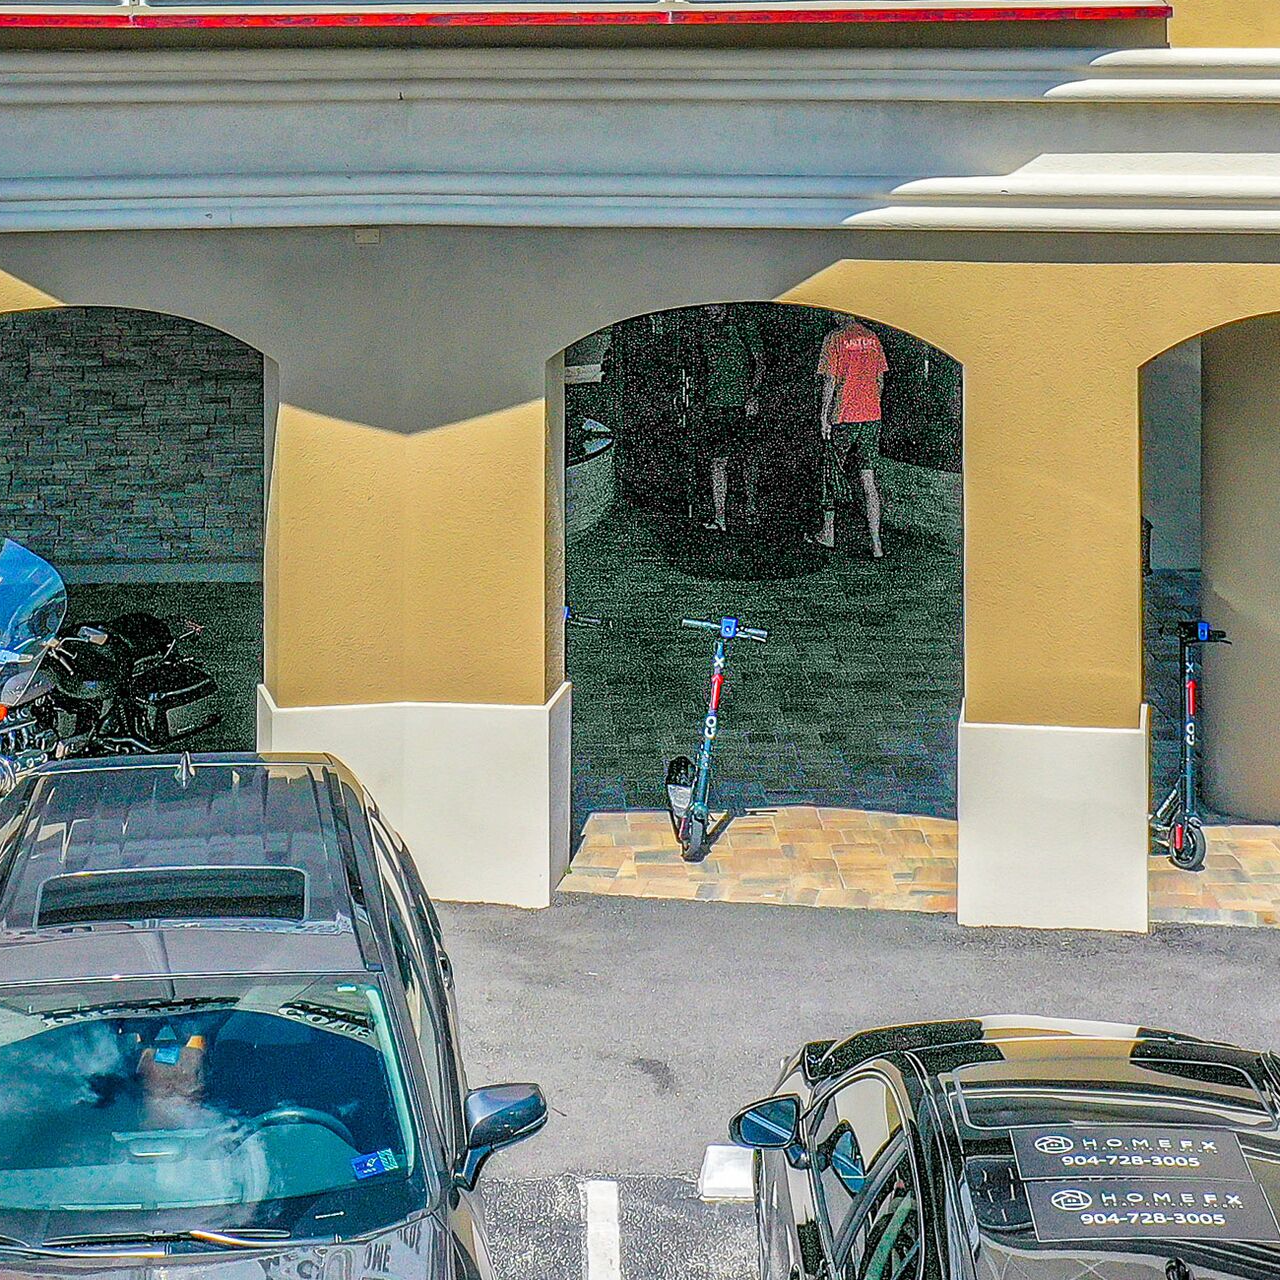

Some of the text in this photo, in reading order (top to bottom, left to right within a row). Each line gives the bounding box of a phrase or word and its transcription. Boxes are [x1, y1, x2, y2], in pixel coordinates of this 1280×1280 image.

[1082, 1138, 1217, 1151] HOMEFX
[1061, 1155, 1201, 1168] 904-728-3005
[1101, 1192, 1243, 1205] HOMEFX
[1080, 1212, 1226, 1225] 904-728-3005
